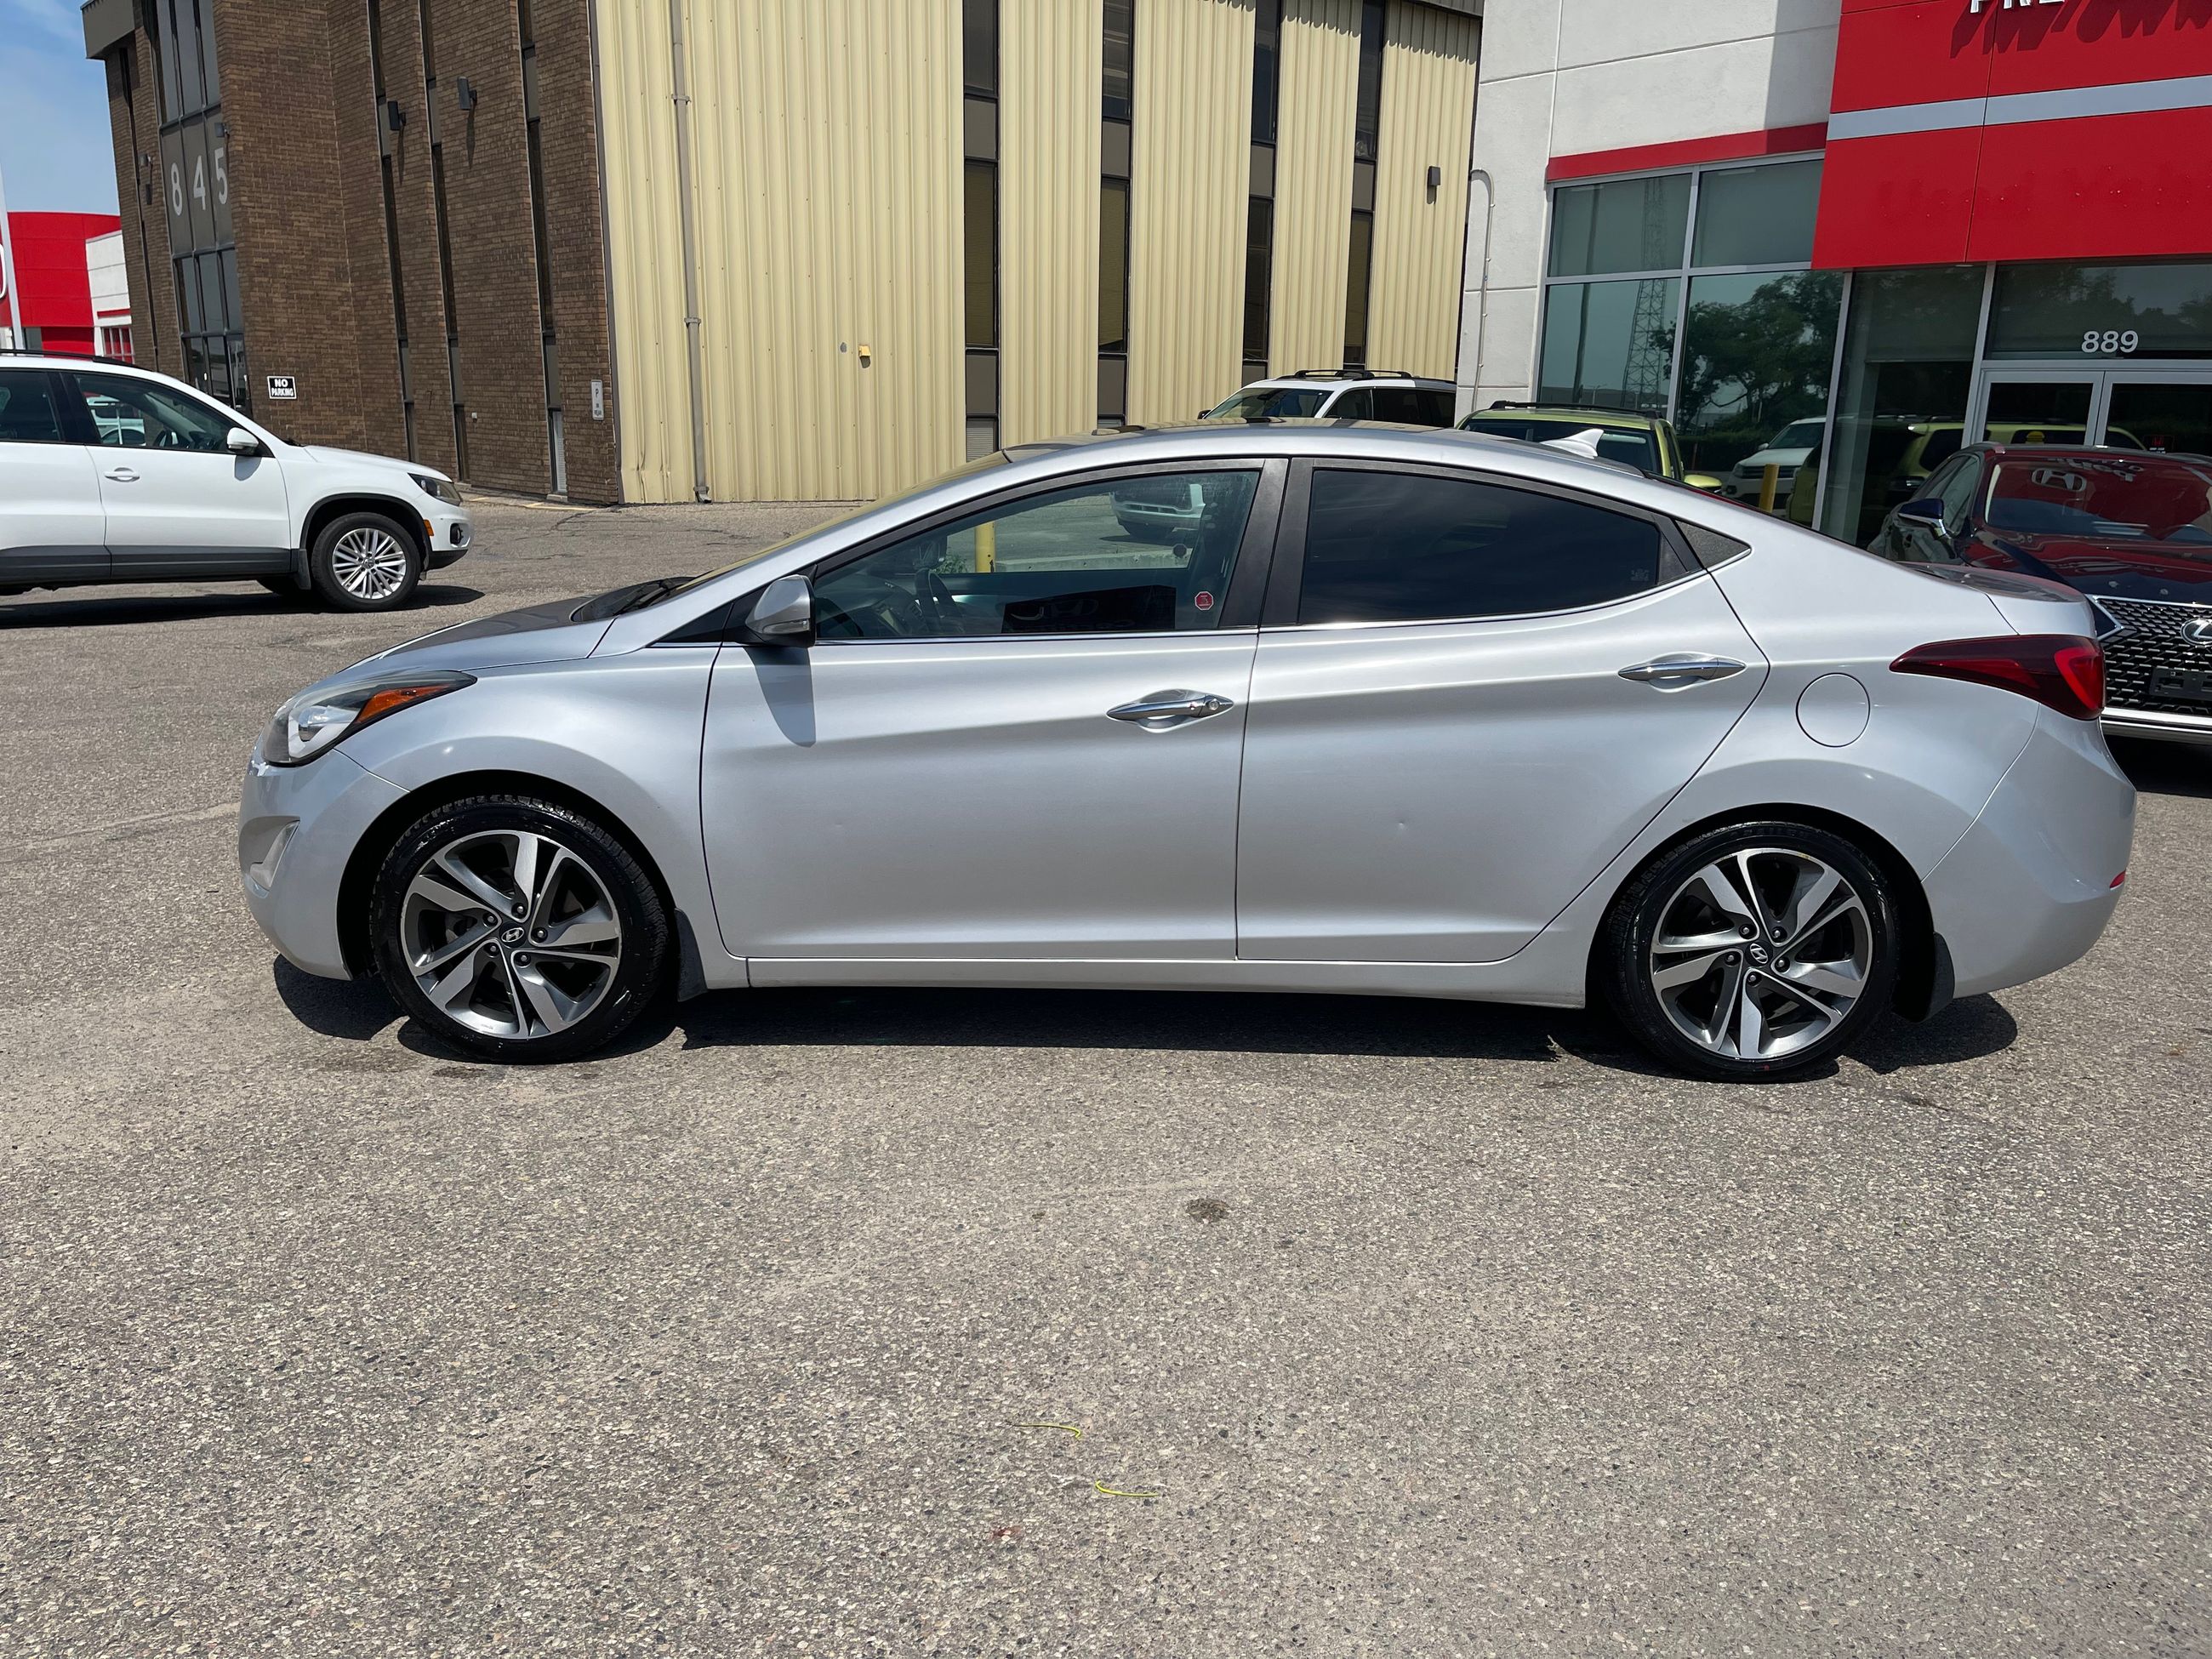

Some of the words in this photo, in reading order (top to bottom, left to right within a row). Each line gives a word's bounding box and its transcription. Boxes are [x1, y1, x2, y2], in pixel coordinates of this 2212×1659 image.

[171, 147, 228, 215] 845
[2081, 330, 2139, 353] 889
[274, 379, 288, 388] NO
[271, 387, 294, 397] PARKING
